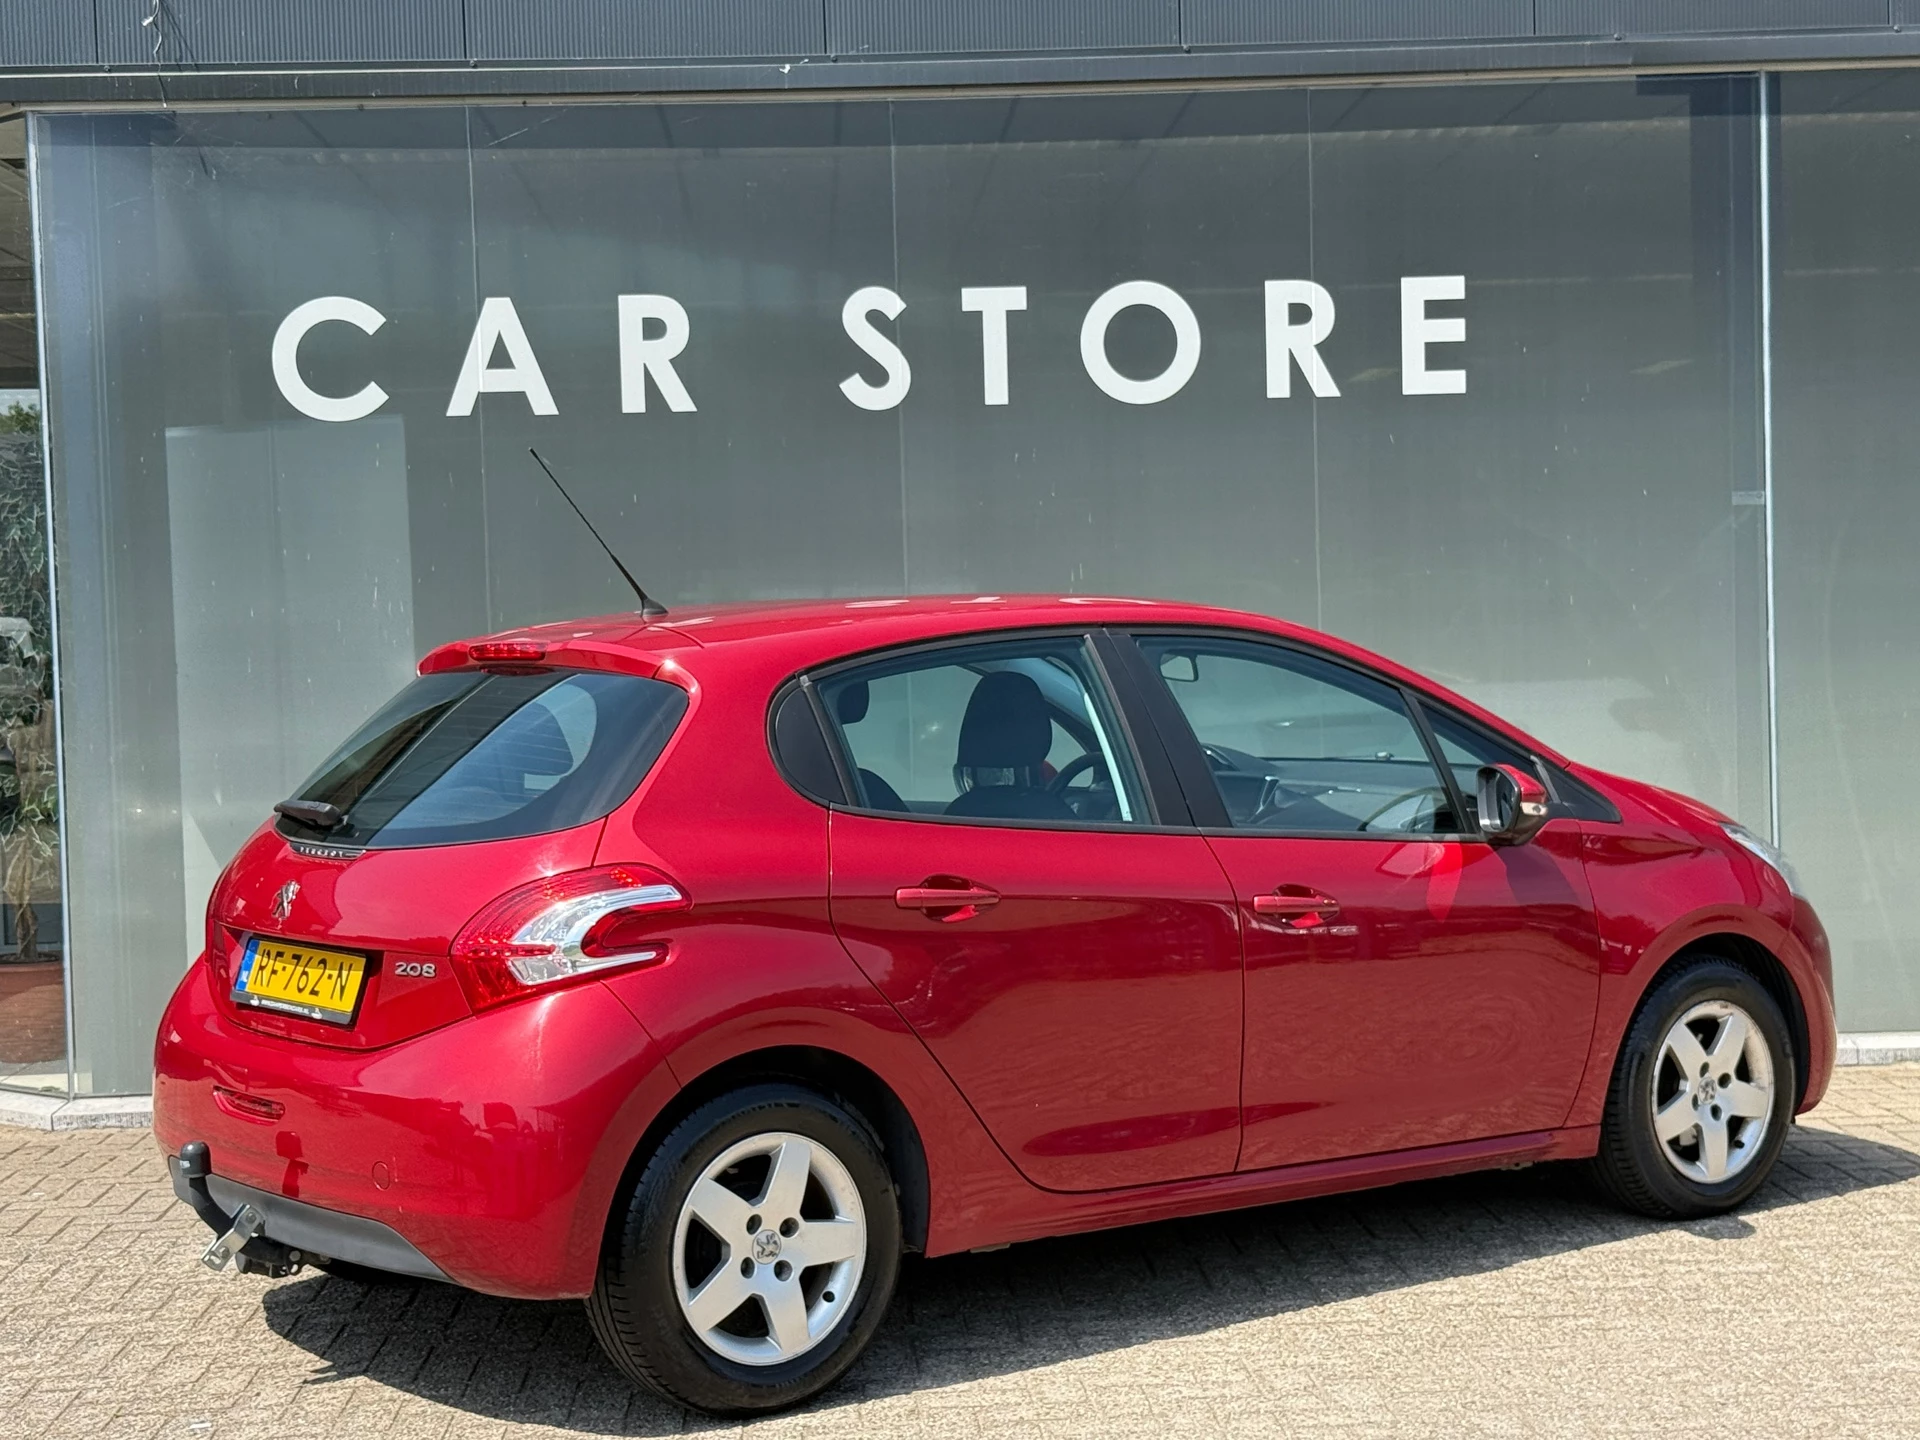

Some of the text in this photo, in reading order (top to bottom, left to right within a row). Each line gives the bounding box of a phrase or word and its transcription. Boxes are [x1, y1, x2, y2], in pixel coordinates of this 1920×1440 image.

[271, 275, 1467, 422] CAR STORE
[253, 948, 354, 1003] RF-762-N
[394, 961, 437, 978] 208
